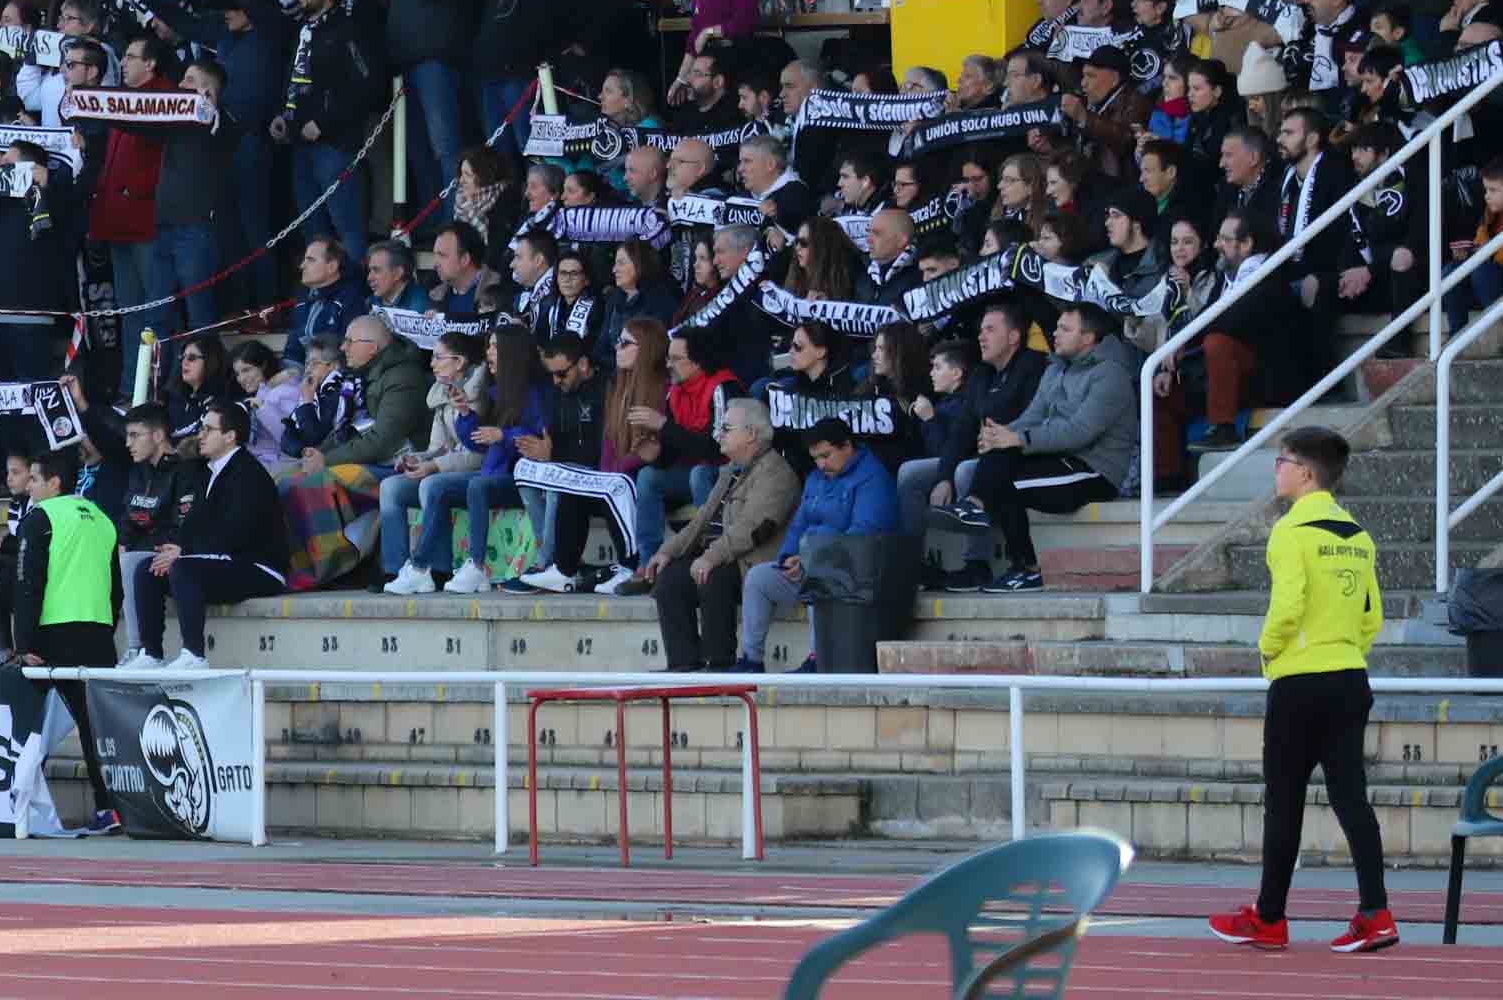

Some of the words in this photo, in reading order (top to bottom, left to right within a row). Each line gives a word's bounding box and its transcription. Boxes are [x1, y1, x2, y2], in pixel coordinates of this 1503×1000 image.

[77, 92, 104, 112] U.D.
[107, 95, 196, 117] SALAMANCA
[854, 104, 867, 125] y
[869, 98, 934, 122] siempre
[925, 120, 959, 142] UNIÓN
[960, 116, 989, 133] SOLO
[989, 111, 1022, 130] HUBO
[1022, 107, 1050, 126] UNA
[565, 207, 642, 236] SALAMANCA
[672, 201, 706, 218] HALA
[510, 638, 527, 655] 49
[577, 638, 593, 656] 47
[642, 638, 658, 656] 45
[773, 645, 788, 662] 41
[409, 727, 425, 744] 47
[101, 764, 146, 793] CUATRO
[216, 764, 254, 792] GATO
